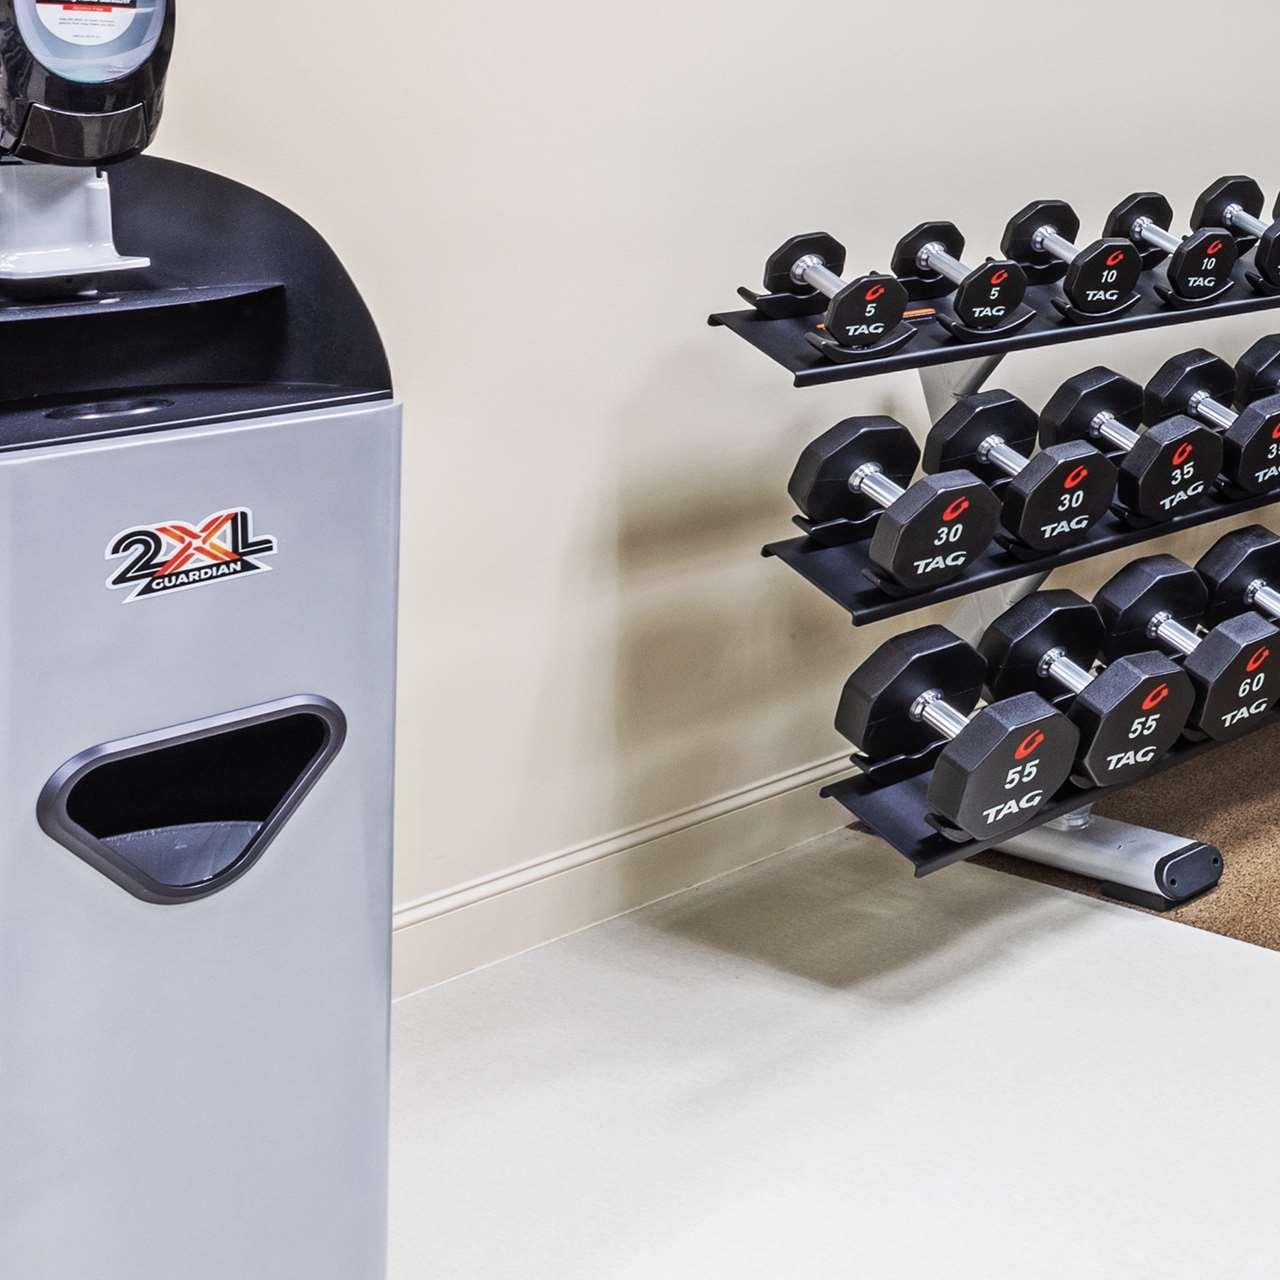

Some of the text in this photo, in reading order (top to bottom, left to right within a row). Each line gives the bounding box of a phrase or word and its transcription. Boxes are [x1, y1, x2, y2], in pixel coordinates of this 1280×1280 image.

[1201, 257, 1217, 270] 10
[1101, 269, 1118, 283] 10
[1187, 276, 1216, 287] TAG
[989, 286, 1001, 300] 5
[1085, 289, 1119, 301] TAG
[864, 303, 877, 317] 5
[971, 305, 1006, 318] TAG
[845, 322, 885, 336] TAG
[1171, 462, 1194, 486] 35
[1058, 491, 1083, 511] 30
[1160, 481, 1203, 509] TAG
[934, 524, 962, 545] 30
[1041, 515, 1088, 538] TAG
[111, 511, 273, 586] 2XL
[914, 551, 966, 574] TAG
[151, 561, 241, 590] GUARDIAN
[1239, 673, 1265, 698] 60
[1222, 698, 1267, 727] TAG
[1129, 714, 1160, 738] 55
[1107, 746, 1156, 770] TAG
[1005, 759, 1040, 790] 55
[983, 789, 1043, 824] TAG
